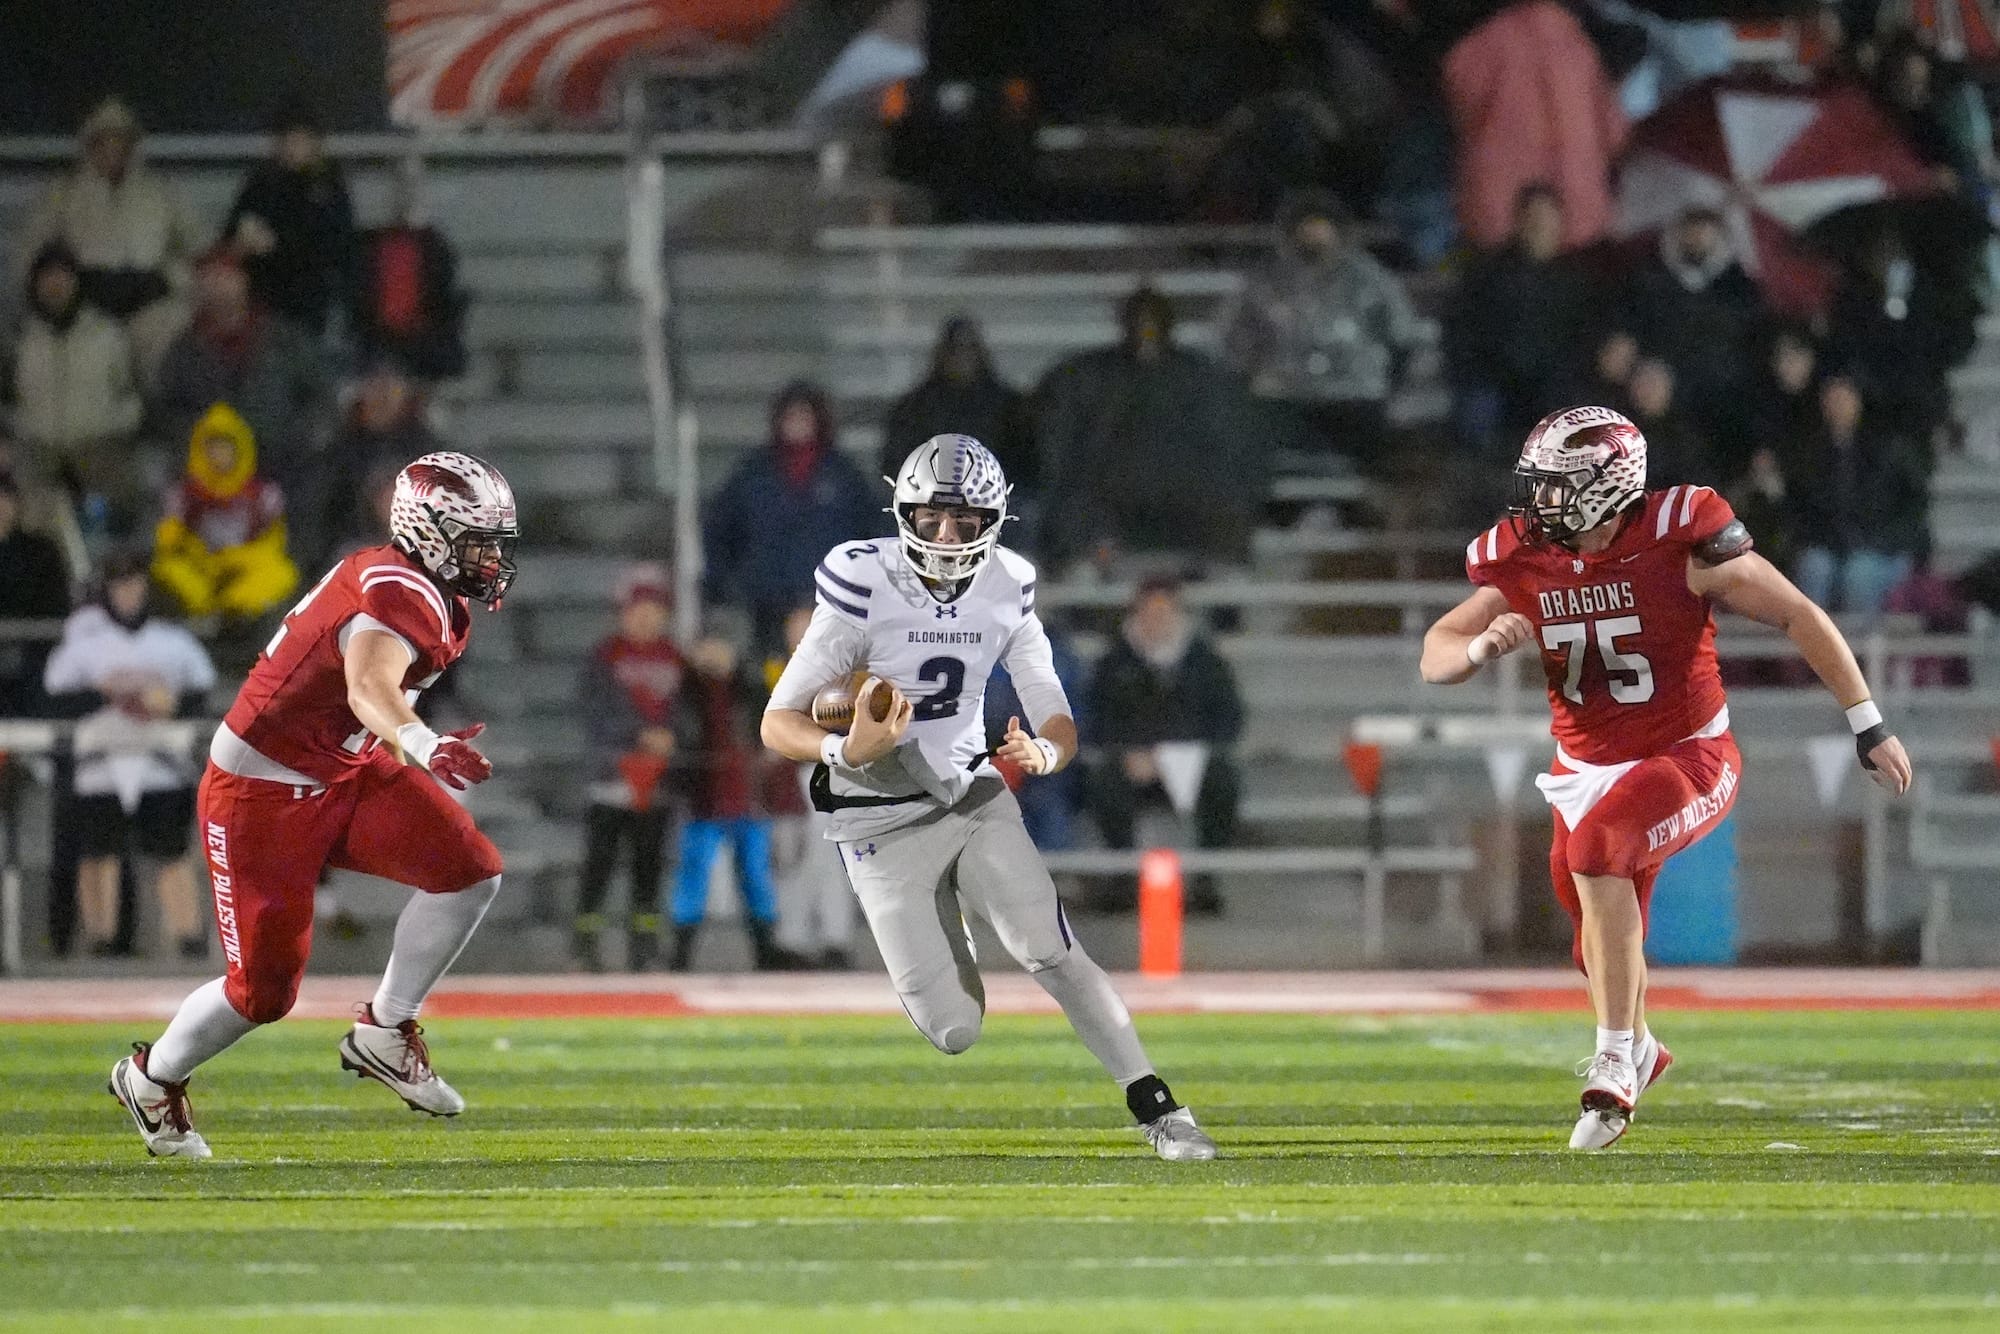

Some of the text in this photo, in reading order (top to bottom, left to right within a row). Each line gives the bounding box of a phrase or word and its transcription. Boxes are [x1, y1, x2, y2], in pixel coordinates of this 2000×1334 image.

[846, 543, 879, 560] 2
[1538, 581, 1635, 619] DRAGONS
[908, 631, 982, 644] BLOOMINGTON
[1541, 615, 1655, 706] 75
[915, 656, 966, 721] 2
[1646, 761, 1738, 852] NEW PALESTINE
[207, 821, 243, 970] NEW PALESTINE
